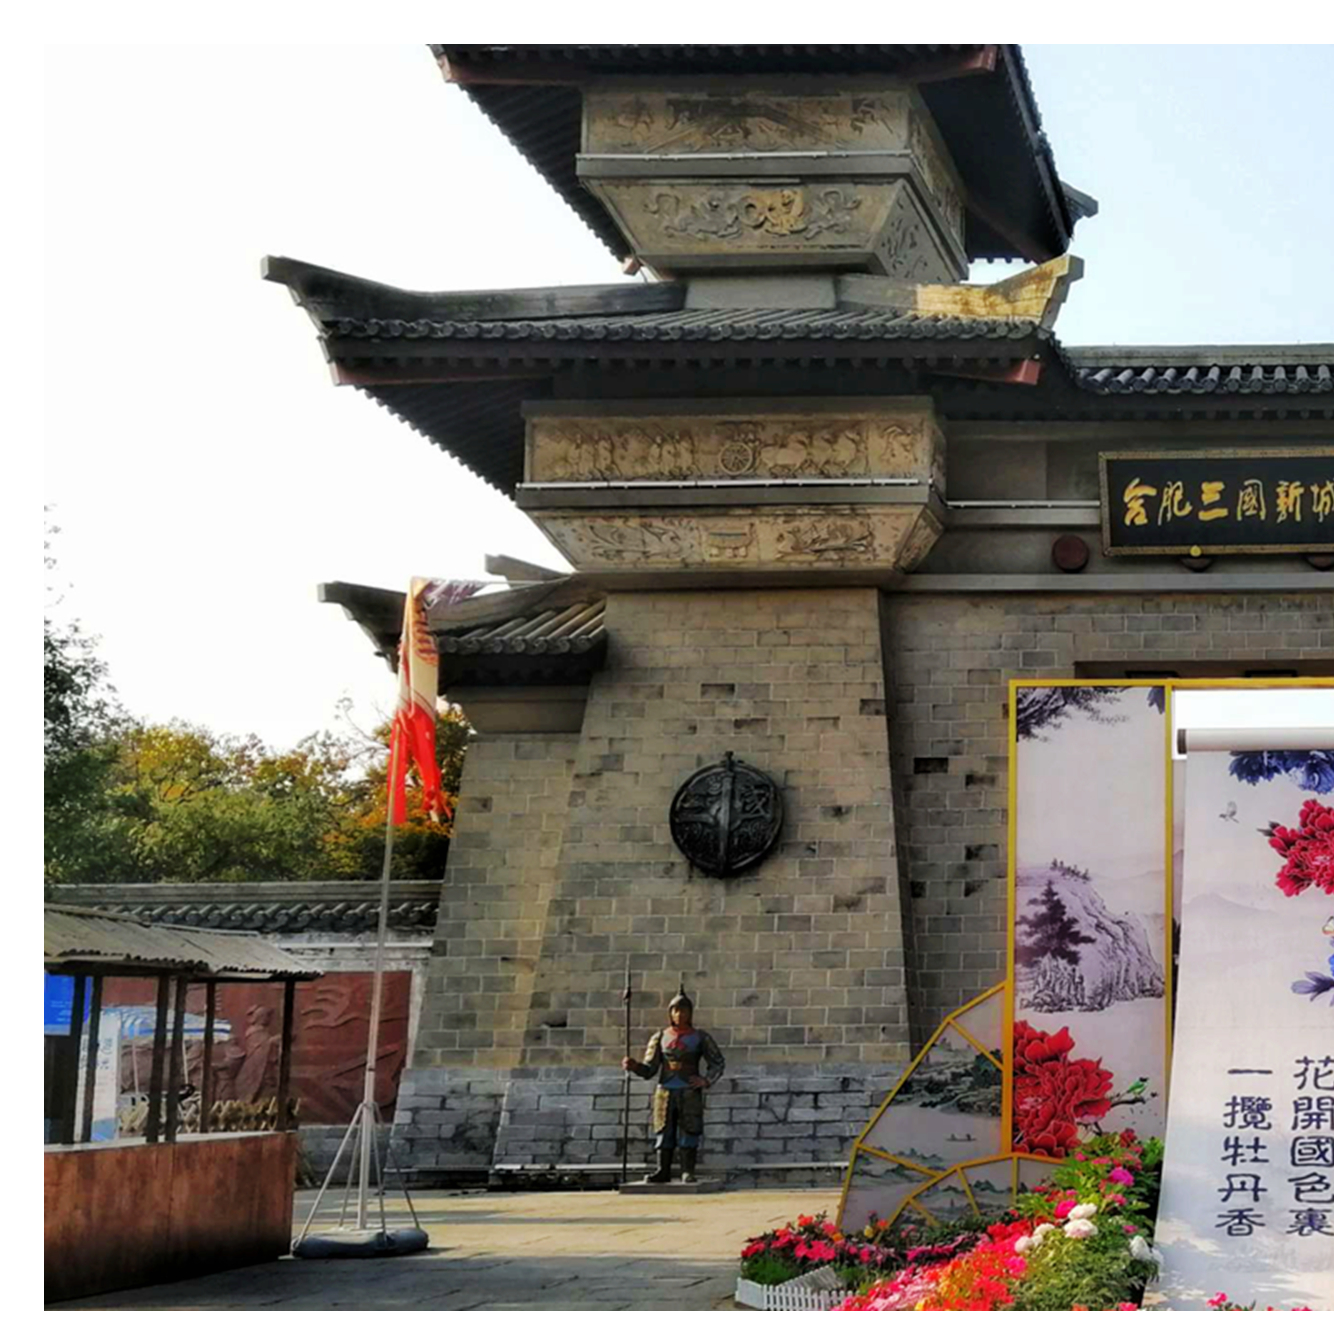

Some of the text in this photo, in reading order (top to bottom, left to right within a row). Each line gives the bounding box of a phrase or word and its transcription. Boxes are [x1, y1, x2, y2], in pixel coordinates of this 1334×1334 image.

[1215, 1068, 1273, 1237] 一攬牡丹香
